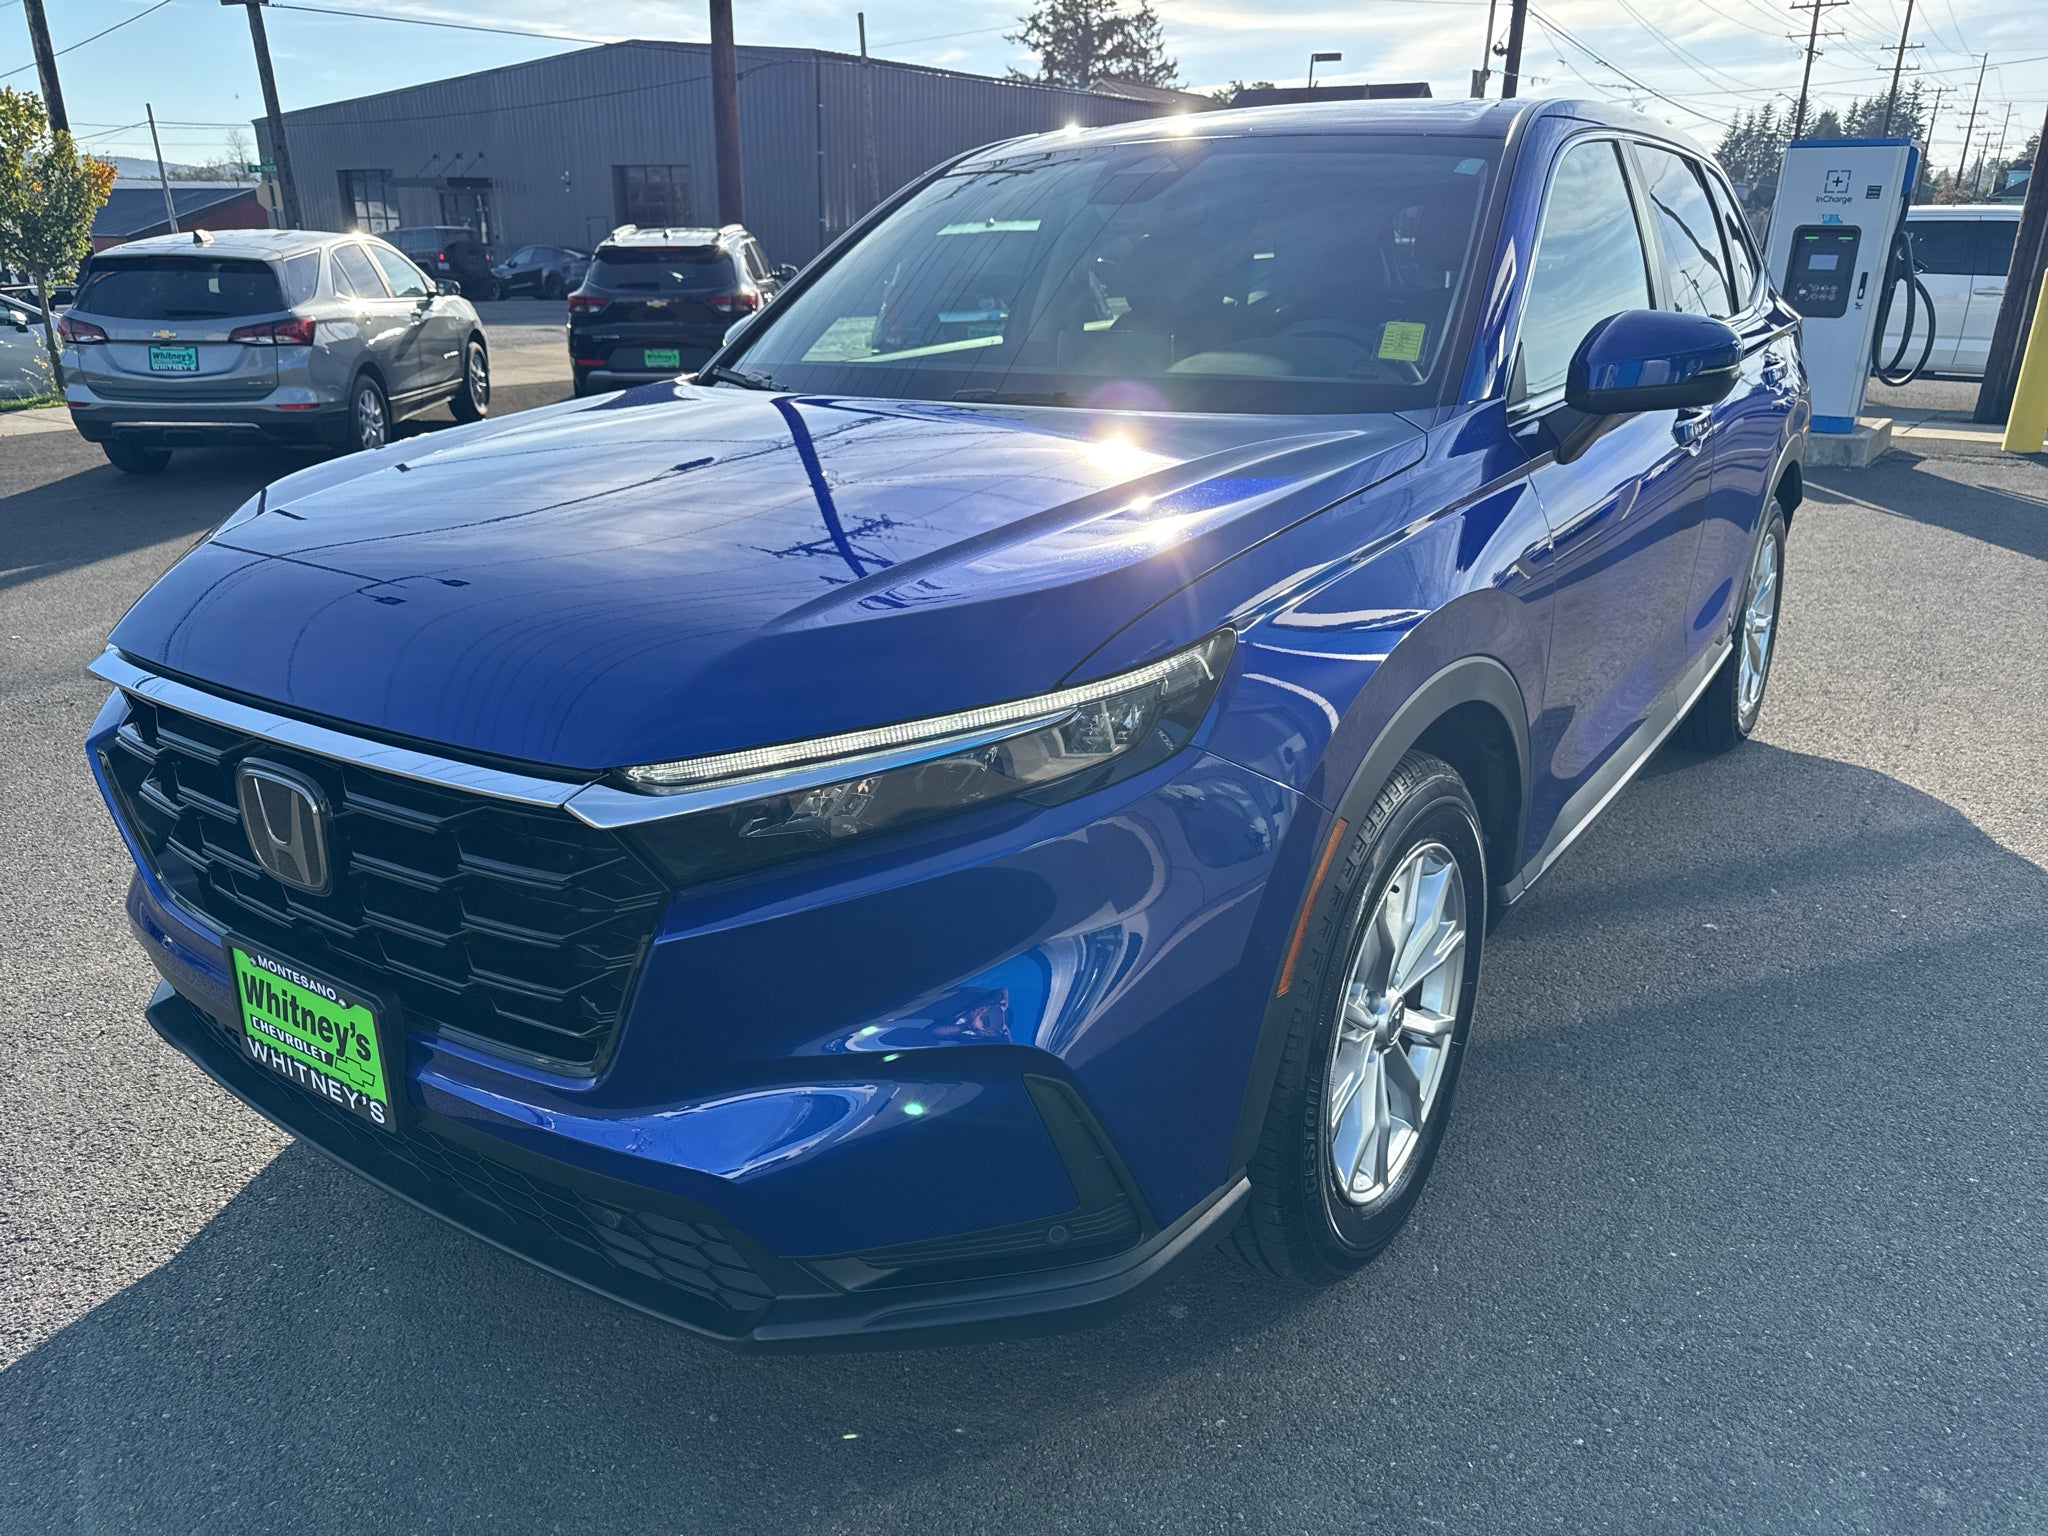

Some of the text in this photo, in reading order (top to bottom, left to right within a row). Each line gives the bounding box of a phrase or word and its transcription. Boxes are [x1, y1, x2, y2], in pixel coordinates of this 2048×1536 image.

[1816, 195, 1852, 204] InCharge
[257, 955, 336, 1001] MONTESANO
[241, 971, 371, 1061] Whitney's
[252, 1016, 328, 1063] CHEVROLET
[247, 1036, 386, 1124] WHITNEY'S
